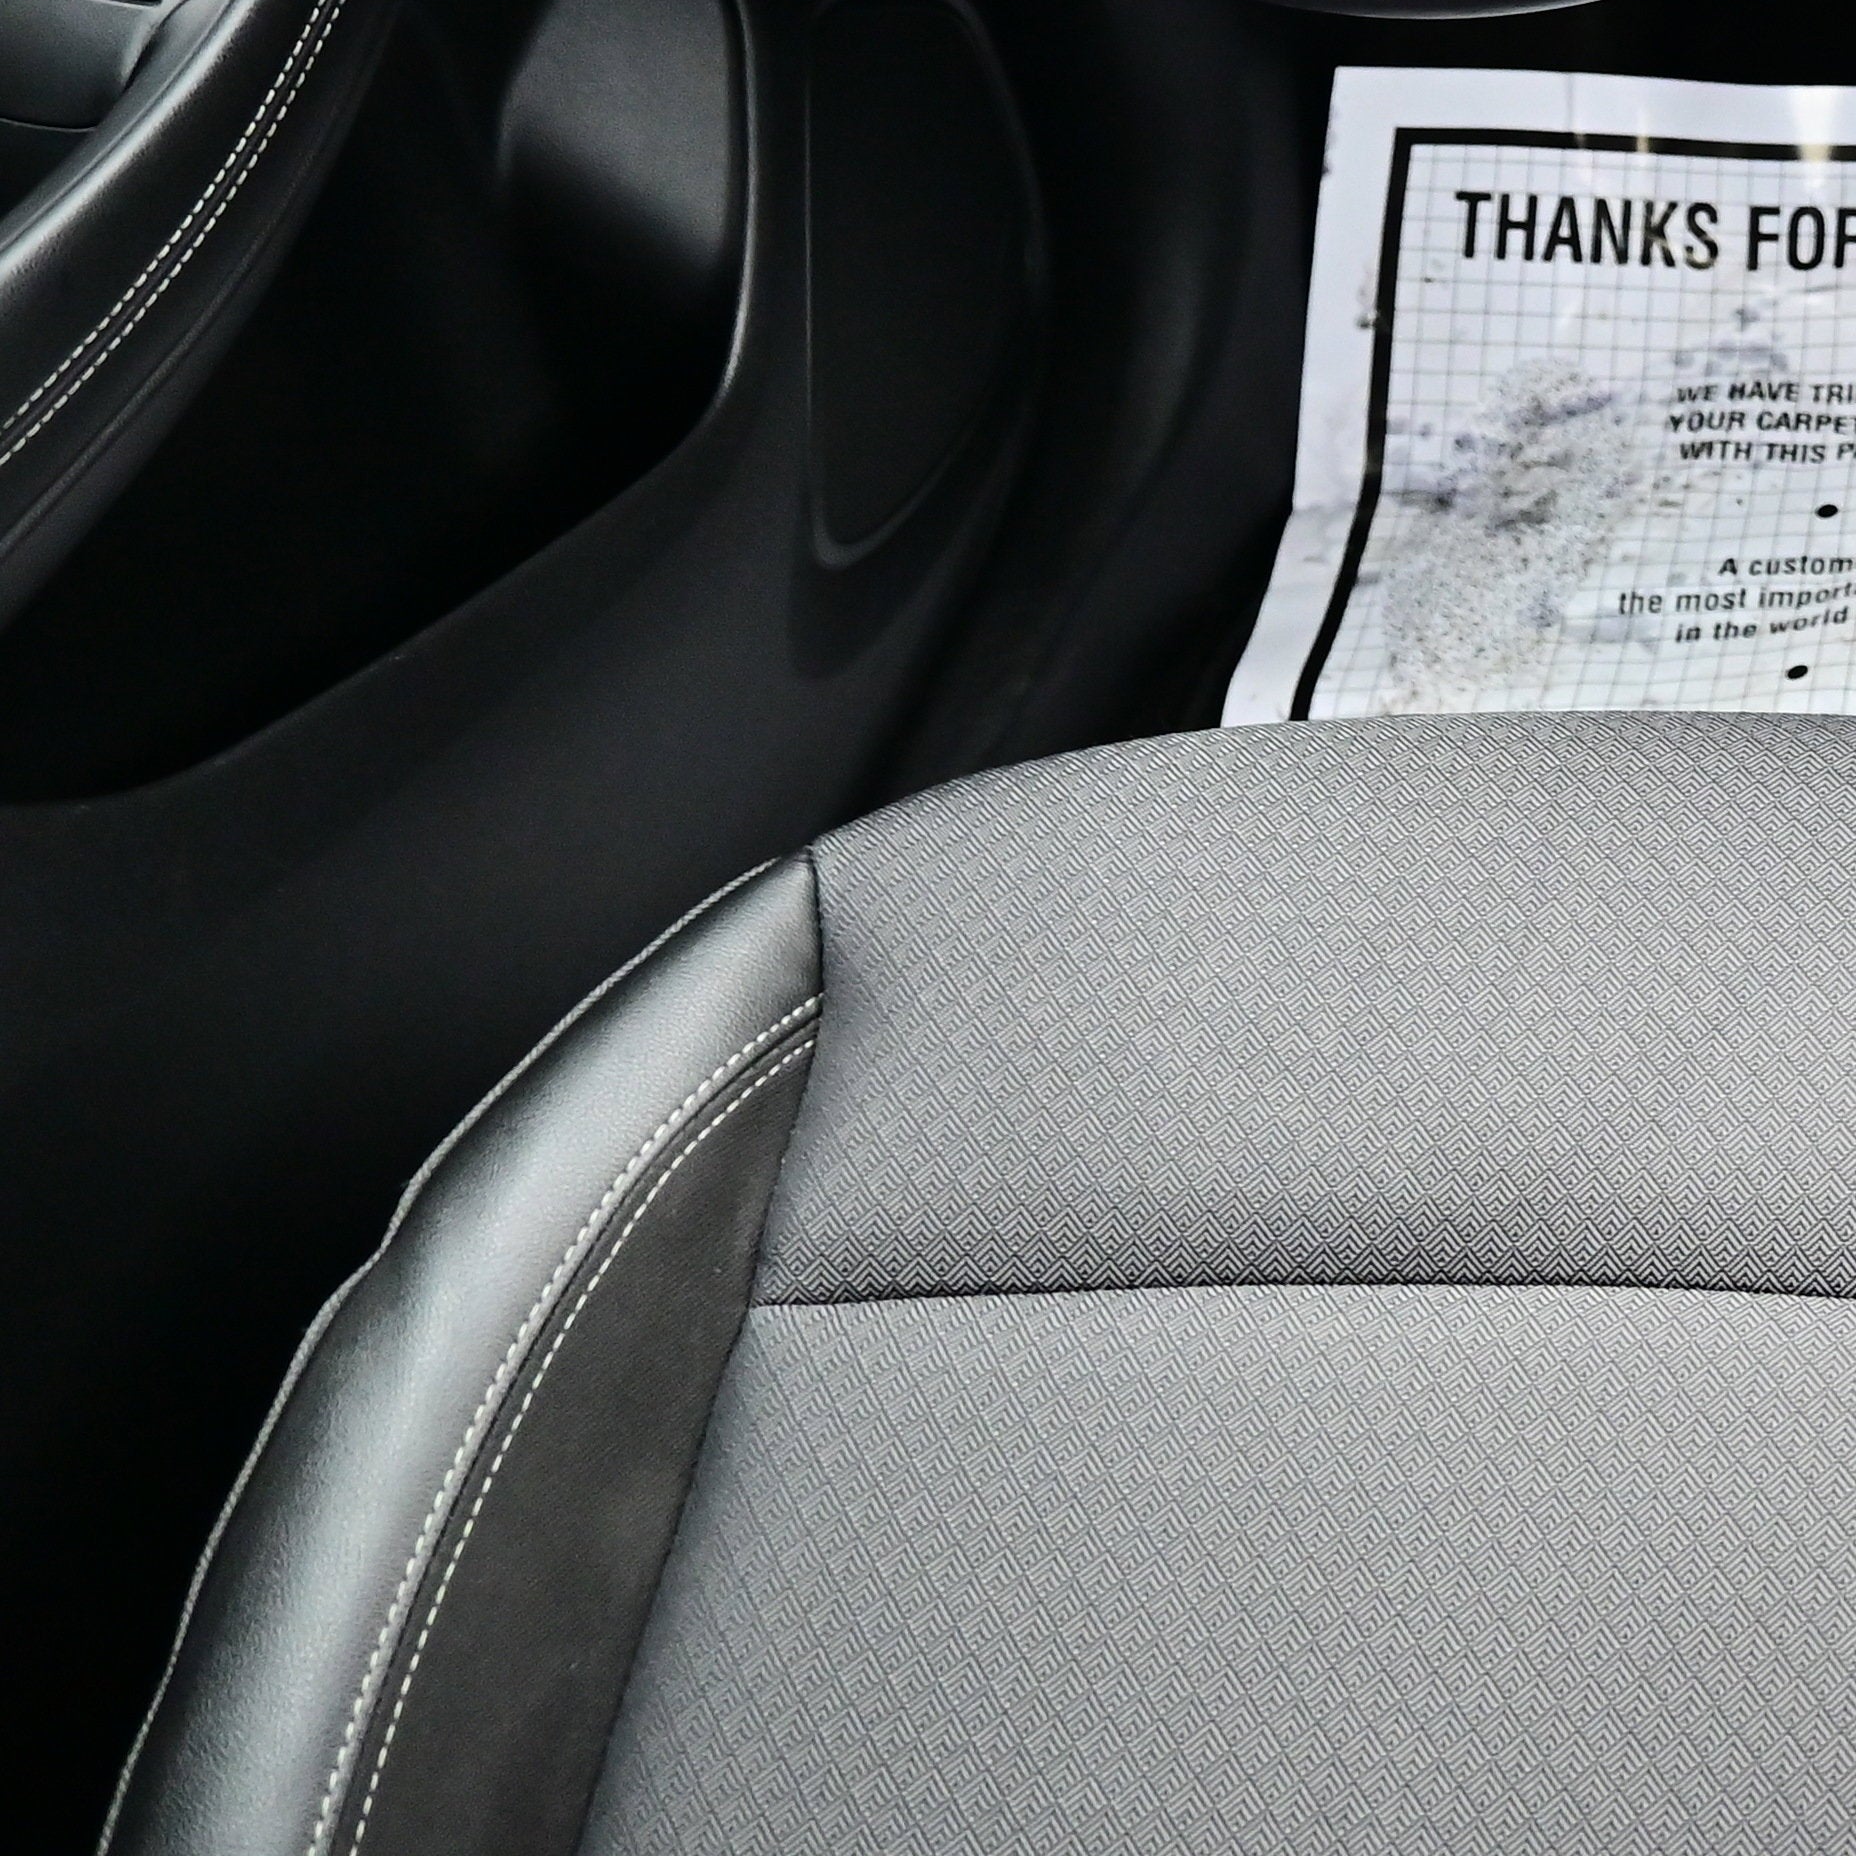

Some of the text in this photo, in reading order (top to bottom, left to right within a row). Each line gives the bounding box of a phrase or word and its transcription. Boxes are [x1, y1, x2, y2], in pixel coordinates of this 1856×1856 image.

[1456, 189, 1720, 272] THANKS
[1676, 384, 1719, 404] WE
[1727, 381, 1800, 403] HAVE
[1669, 411, 1747, 434] YOUR
[1679, 439, 1752, 461] WITH
[1764, 442, 1827, 465] THIS
[1717, 557, 1739, 577] A
[1619, 591, 1664, 615] the
[1674, 587, 1747, 614] most
[1675, 623, 1702, 643] in
[1712, 618, 1758, 641] the
[1767, 604, 1848, 636] world
